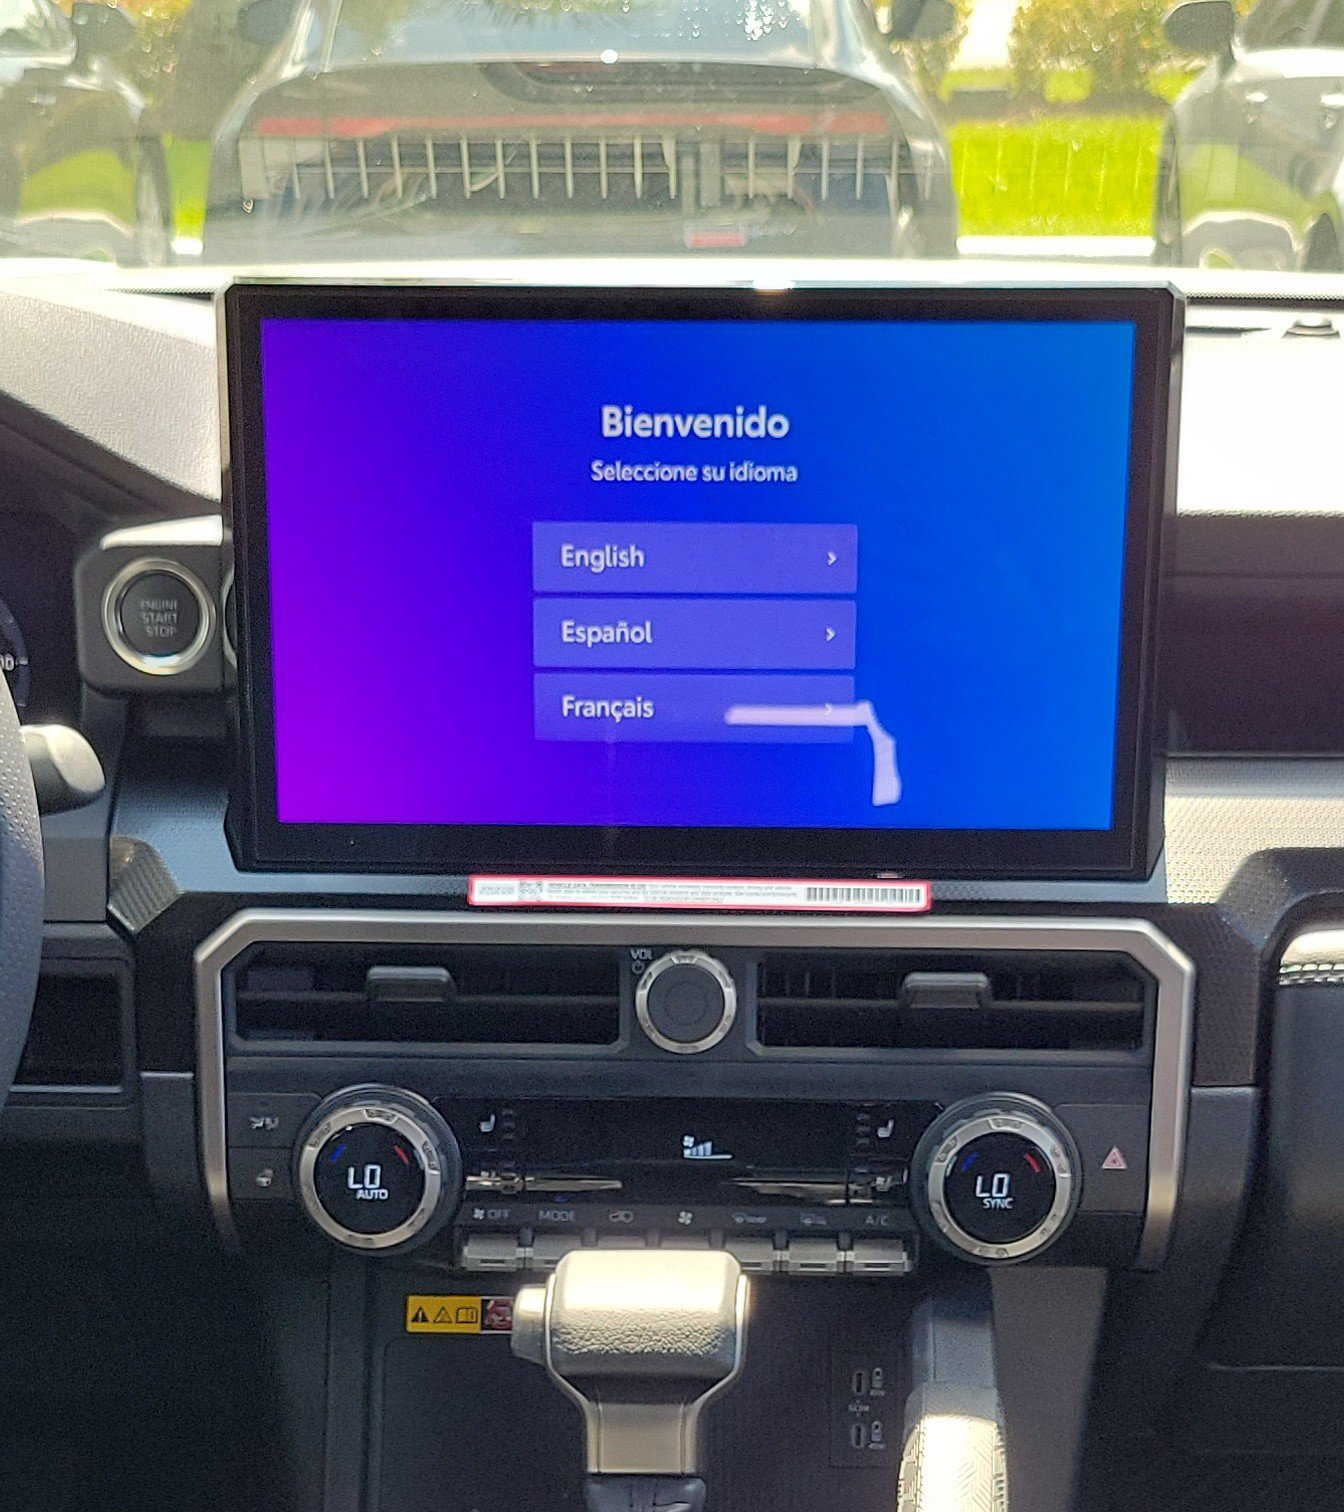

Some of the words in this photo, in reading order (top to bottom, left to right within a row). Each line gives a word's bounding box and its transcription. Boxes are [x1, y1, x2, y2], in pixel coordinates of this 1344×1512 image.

[601, 404, 791, 438] Bienvenido
[590, 459, 698, 482] Seleccione
[702, 464, 726, 482] su
[729, 460, 799, 482] idioma
[560, 543, 646, 573] English
[561, 619, 654, 648] Español
[561, 694, 655, 723] Français
[629, 948, 654, 960] VOL
[347, 1163, 382, 1190] LO
[975, 1172, 1011, 1198] LO
[356, 1188, 389, 1200] AUTO
[982, 1197, 1014, 1210] SYNC
